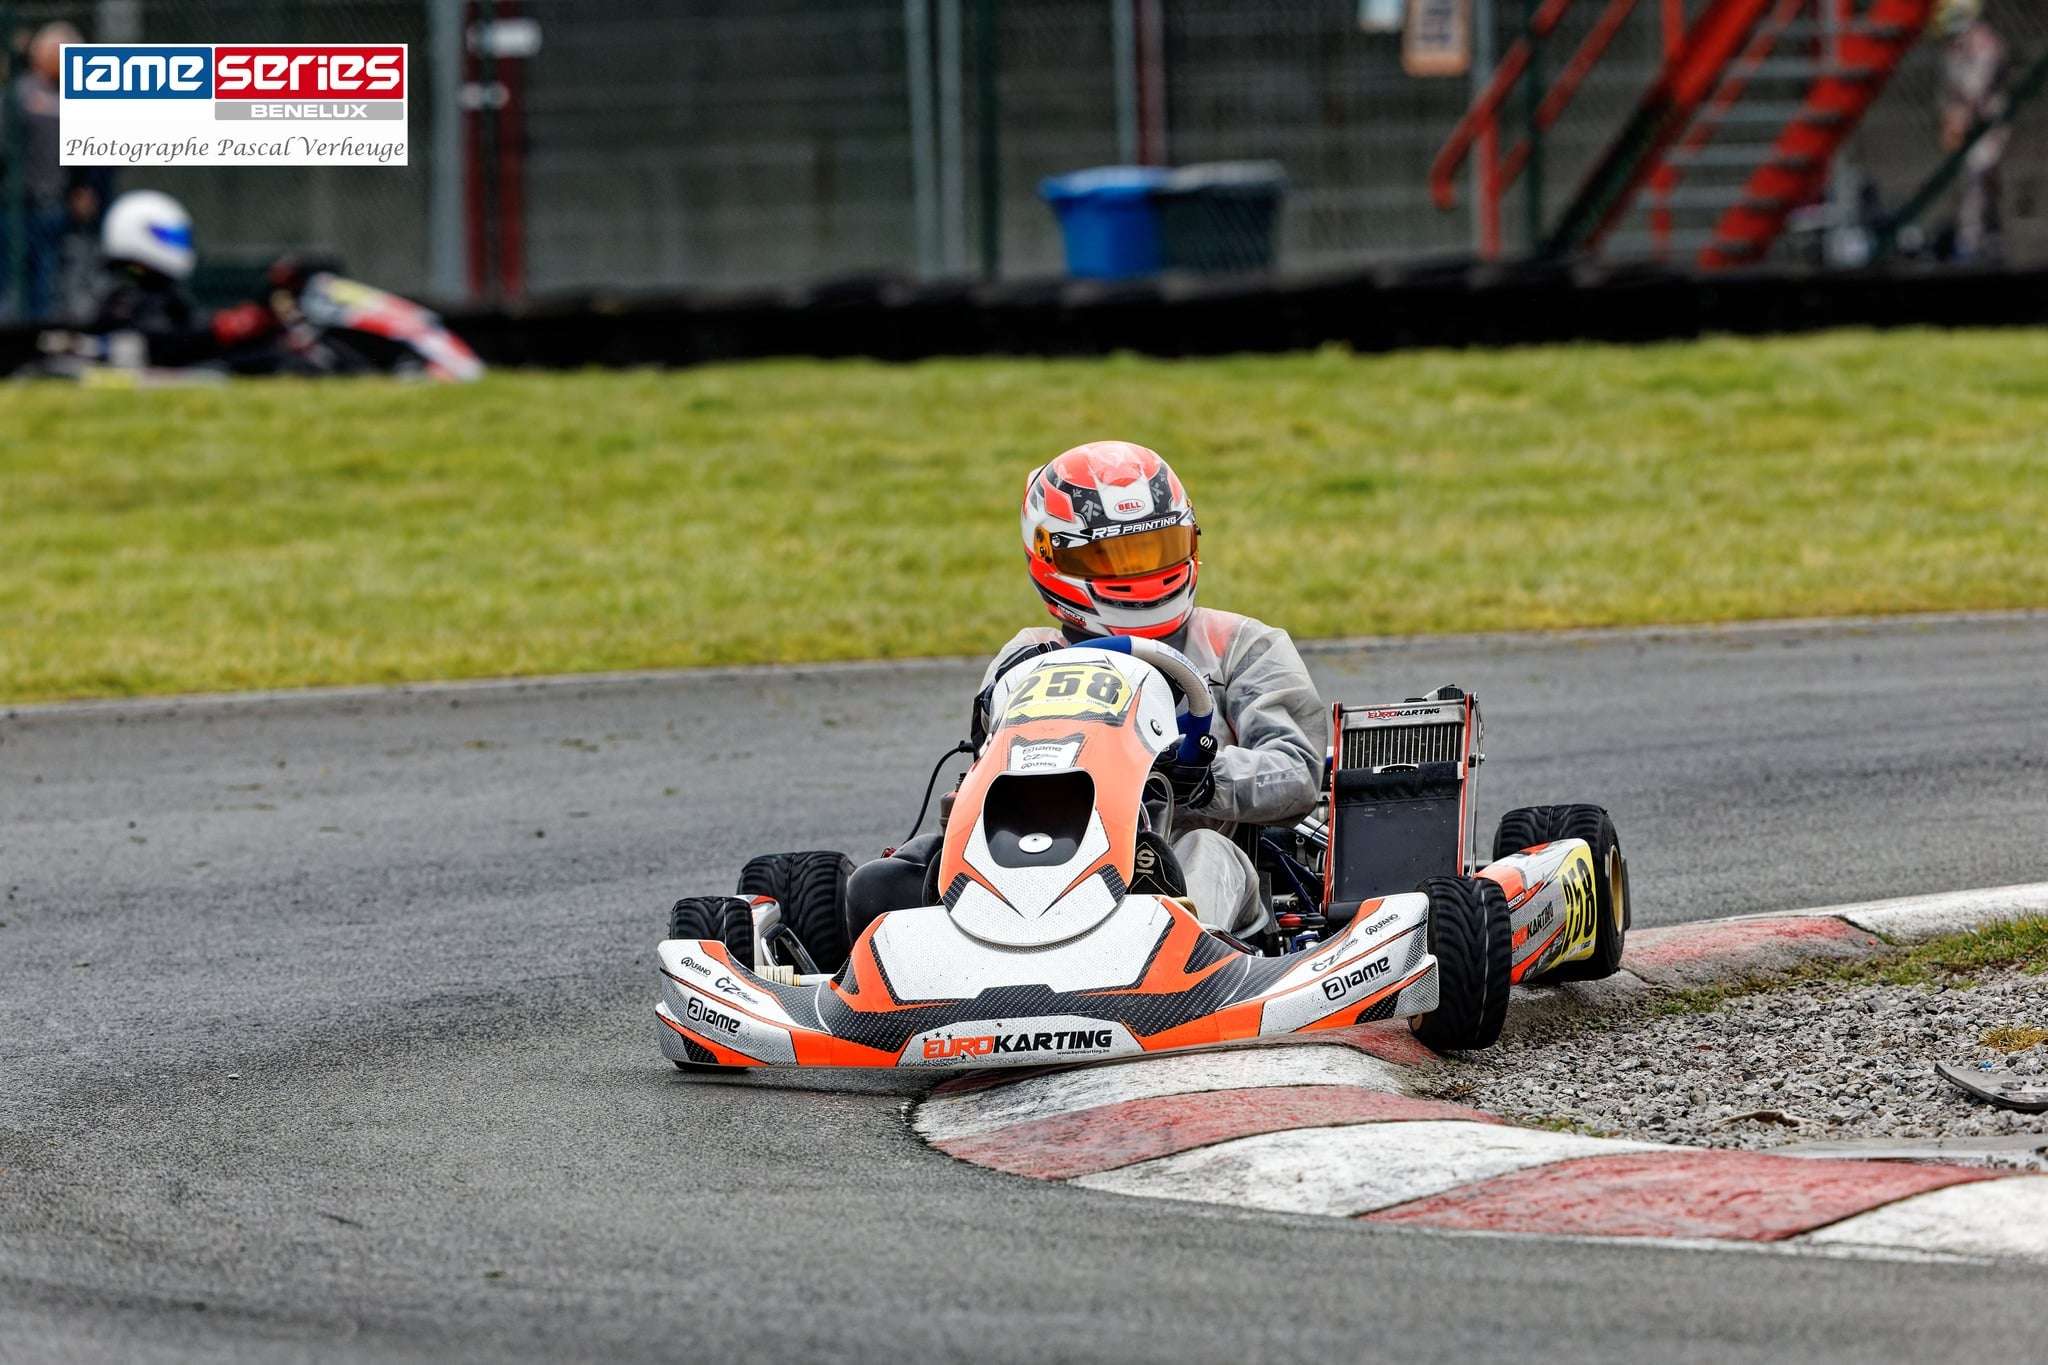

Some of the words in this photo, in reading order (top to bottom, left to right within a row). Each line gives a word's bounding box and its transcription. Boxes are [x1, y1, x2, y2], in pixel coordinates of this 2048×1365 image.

[1118, 502, 1142, 511] BELL
[1091, 524, 1122, 540] RS
[1009, 670, 1122, 709] 258
[1368, 707, 1441, 719] EUROKARTING
[1560, 857, 1596, 955] 258
[923, 1029, 1112, 1059] EUROKARTING
